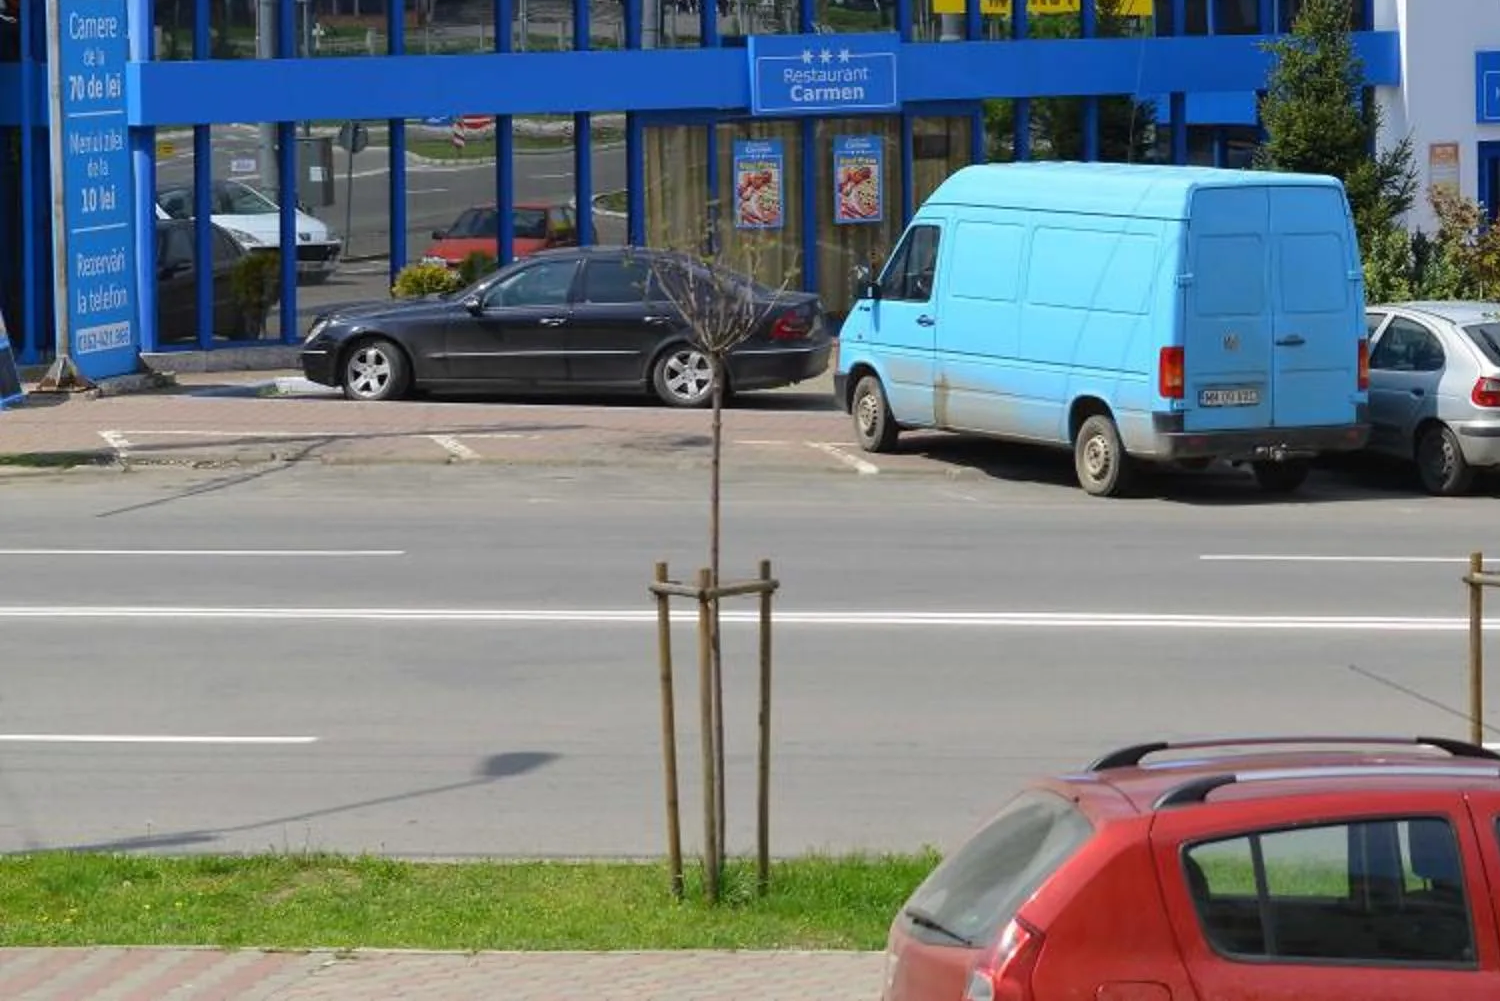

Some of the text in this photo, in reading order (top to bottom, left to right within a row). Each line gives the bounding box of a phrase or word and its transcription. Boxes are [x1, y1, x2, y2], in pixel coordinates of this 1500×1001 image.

[69, 11, 118, 40] Camere
[68, 72, 121, 102] 70 de lei
[783, 66, 869, 84] Restaurant
[790, 84, 865, 102] Carmen
[81, 184, 115, 213] 10 lei
[78, 282, 128, 315] la telefon
